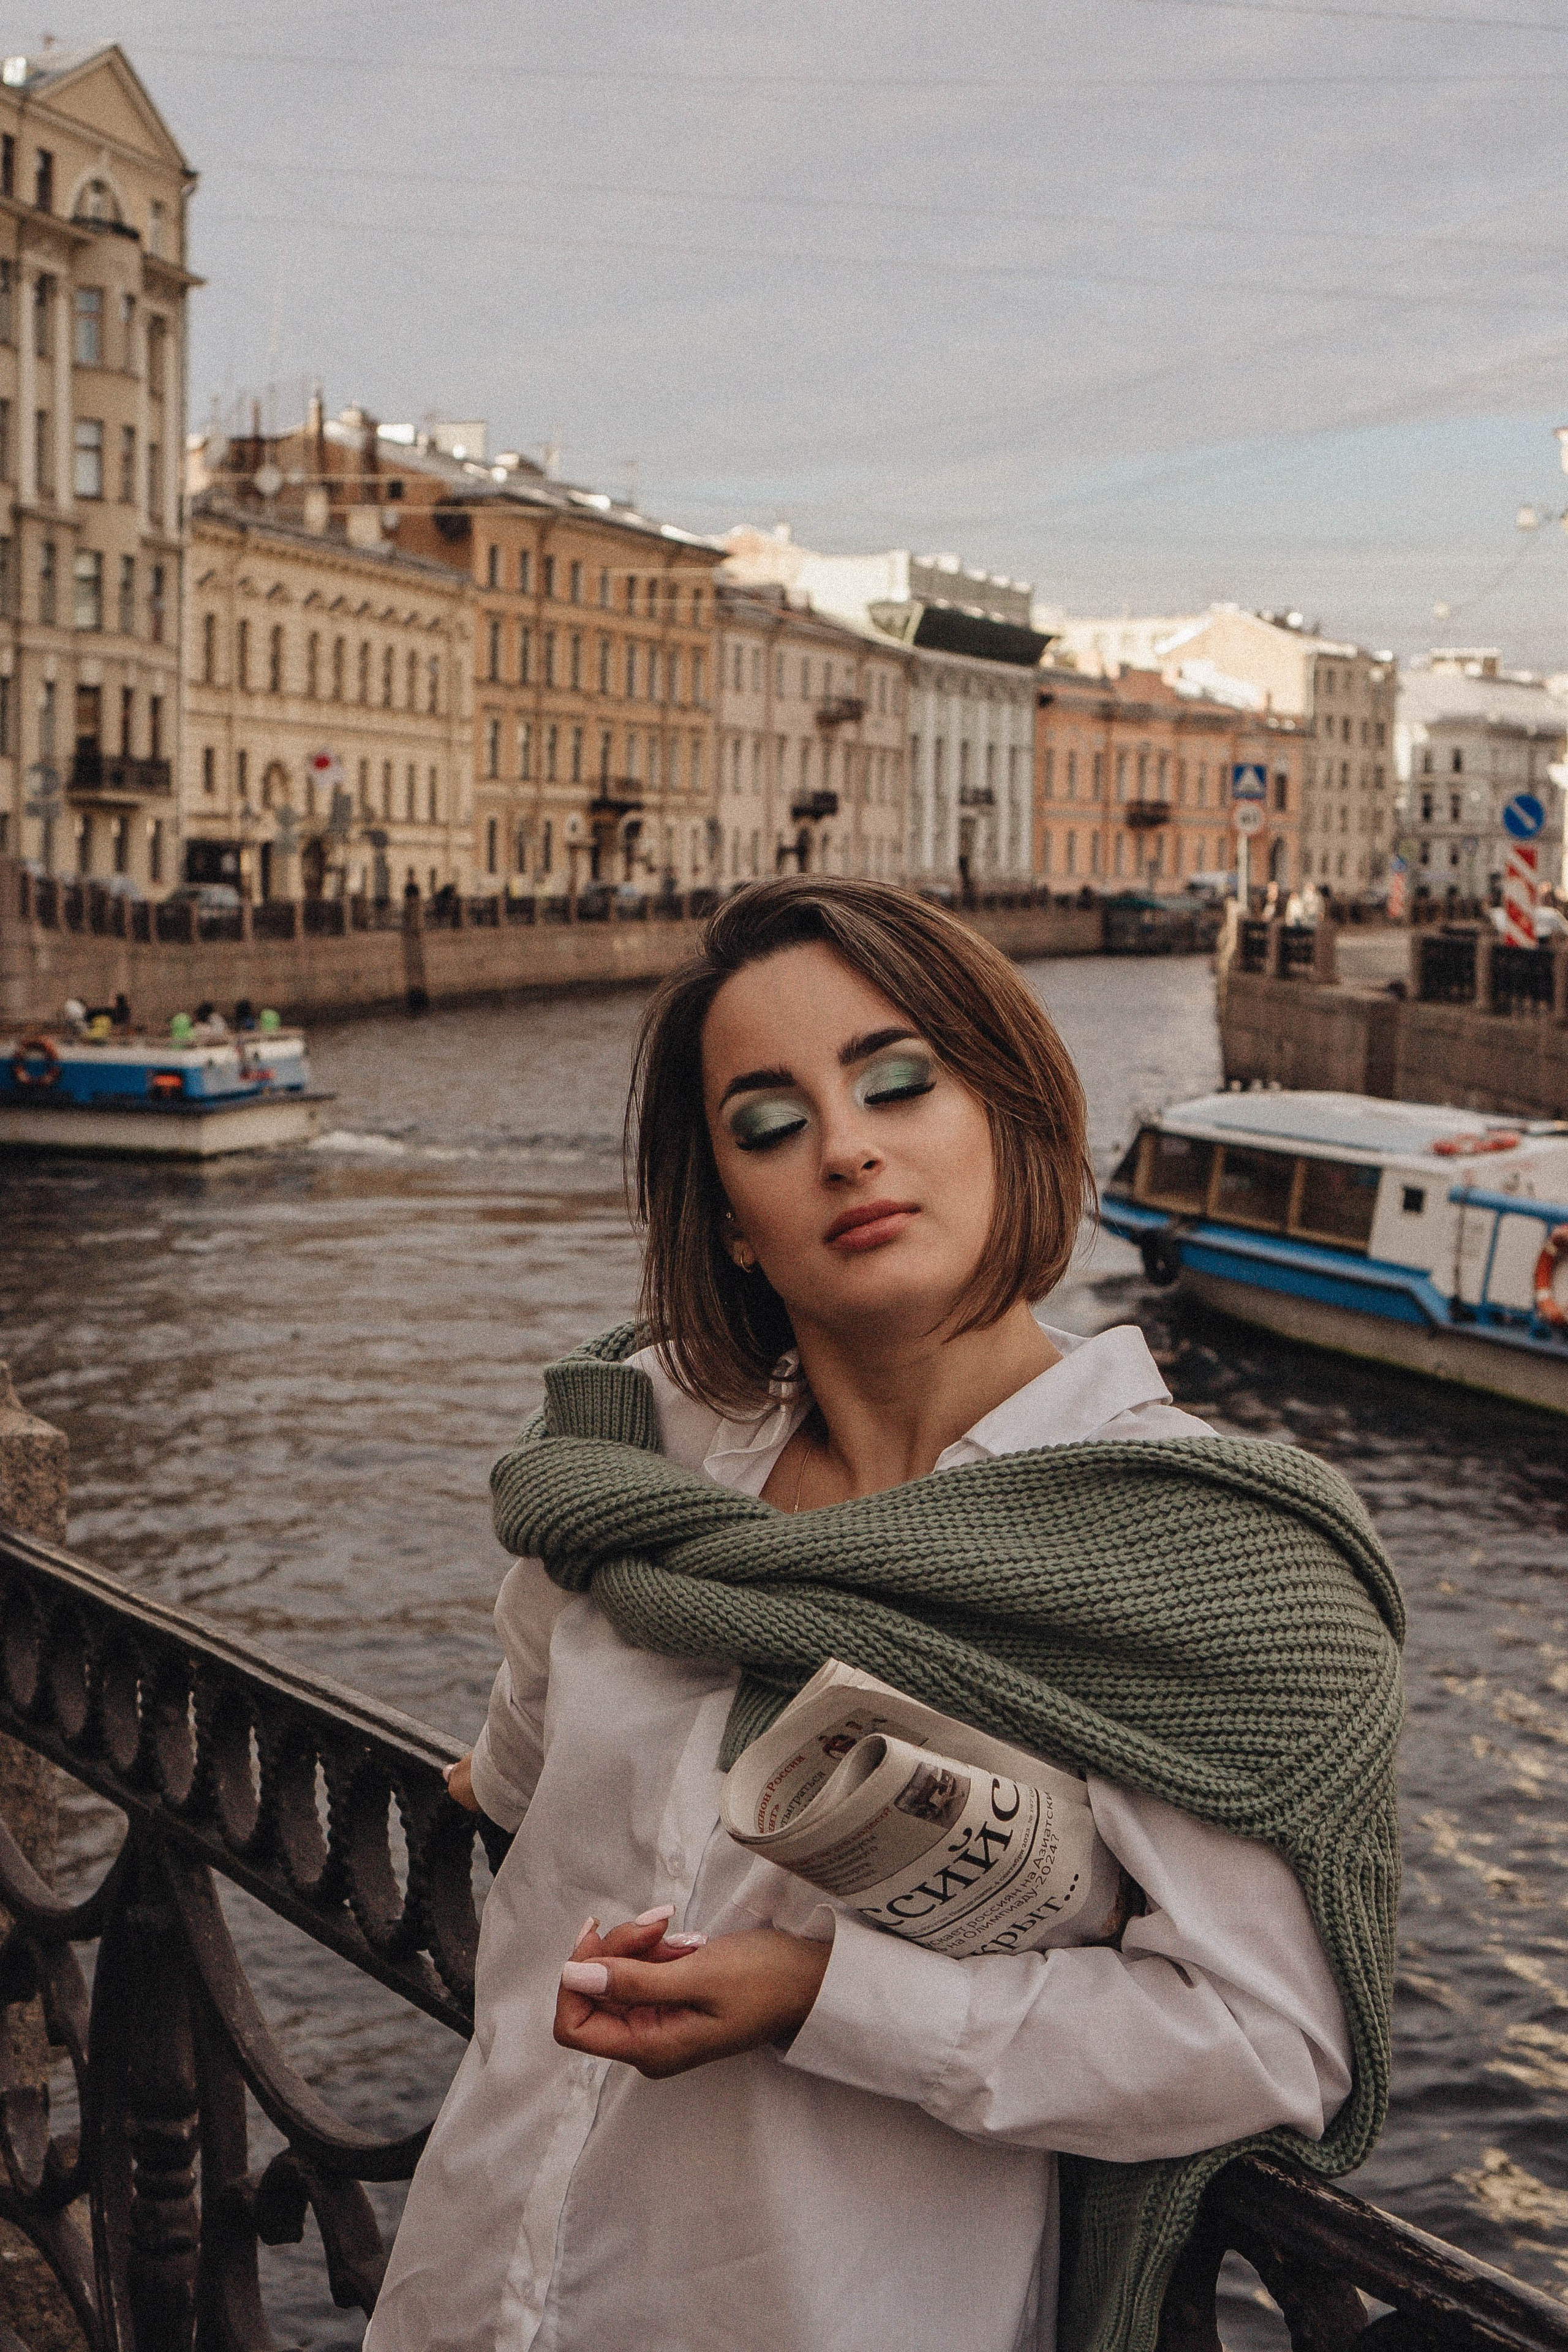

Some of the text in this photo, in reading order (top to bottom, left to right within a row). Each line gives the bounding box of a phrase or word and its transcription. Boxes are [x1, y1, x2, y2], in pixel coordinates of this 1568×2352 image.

[949, 1938, 965, 1950] на
[963, 1834, 1060, 1939] Олимпиаду-2024?
[968, 1888, 1022, 1928] россиян
[1020, 1871, 1037, 1888] на
[1033, 1792, 1054, 1870] Азиатски
